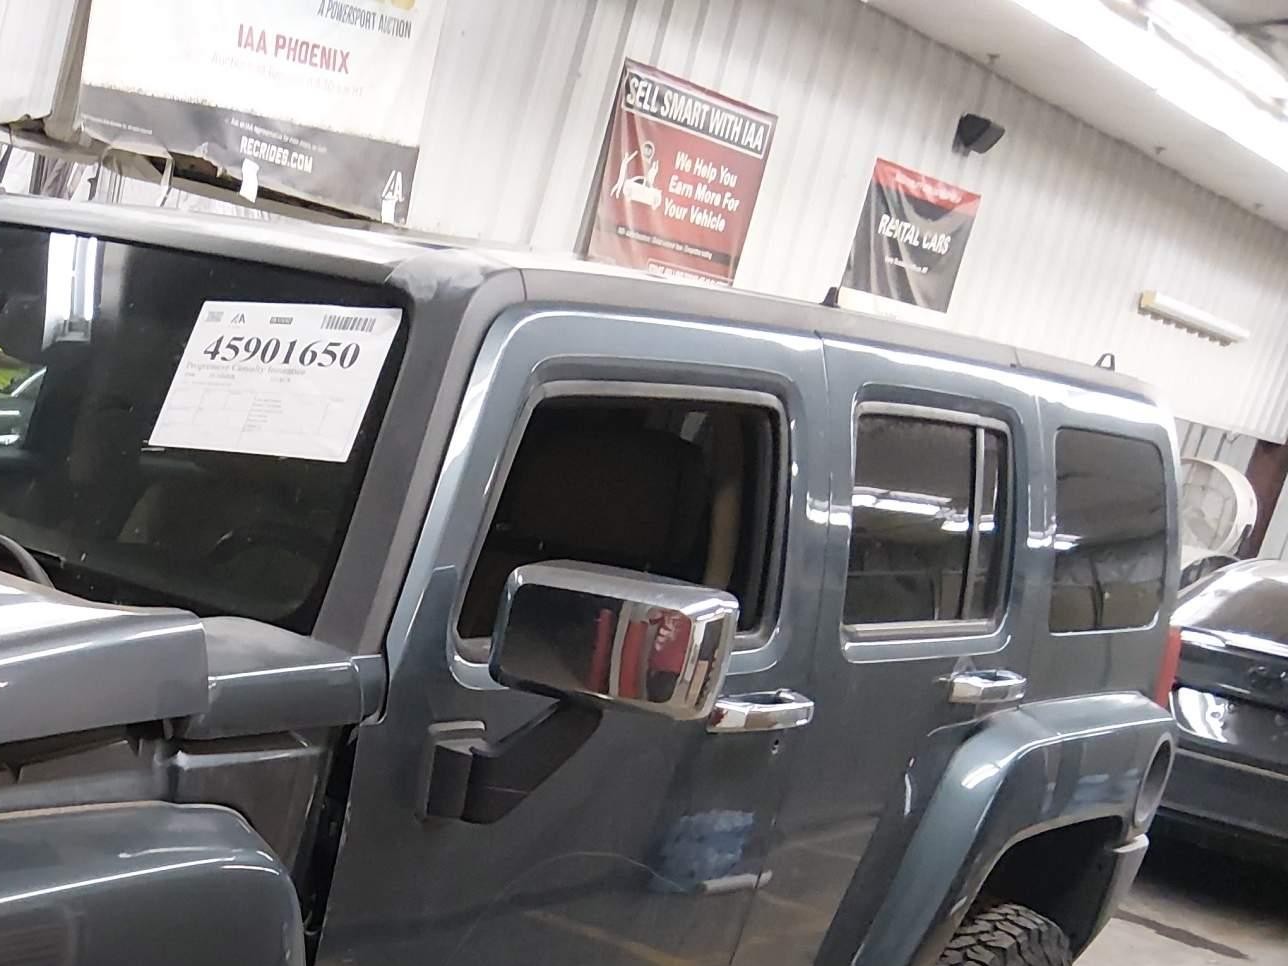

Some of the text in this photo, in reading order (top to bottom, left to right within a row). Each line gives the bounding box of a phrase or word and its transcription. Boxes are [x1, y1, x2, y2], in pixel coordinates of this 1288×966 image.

[317, 0, 412, 39] A POWERSPORT AUCTION
[237, 23, 267, 55] IAA
[274, 33, 350, 74] PHOENIX
[626, 77, 765, 151] SELL SMART WITH IAA
[239, 135, 313, 173] RECRIDES.COM
[674, 151, 738, 188] We Help You
[668, 174, 740, 212] Earn More For
[664, 197, 726, 232] Your Vehicle
[878, 213, 951, 255] RENTAL CARS
[203, 334, 360, 369] 45901650
